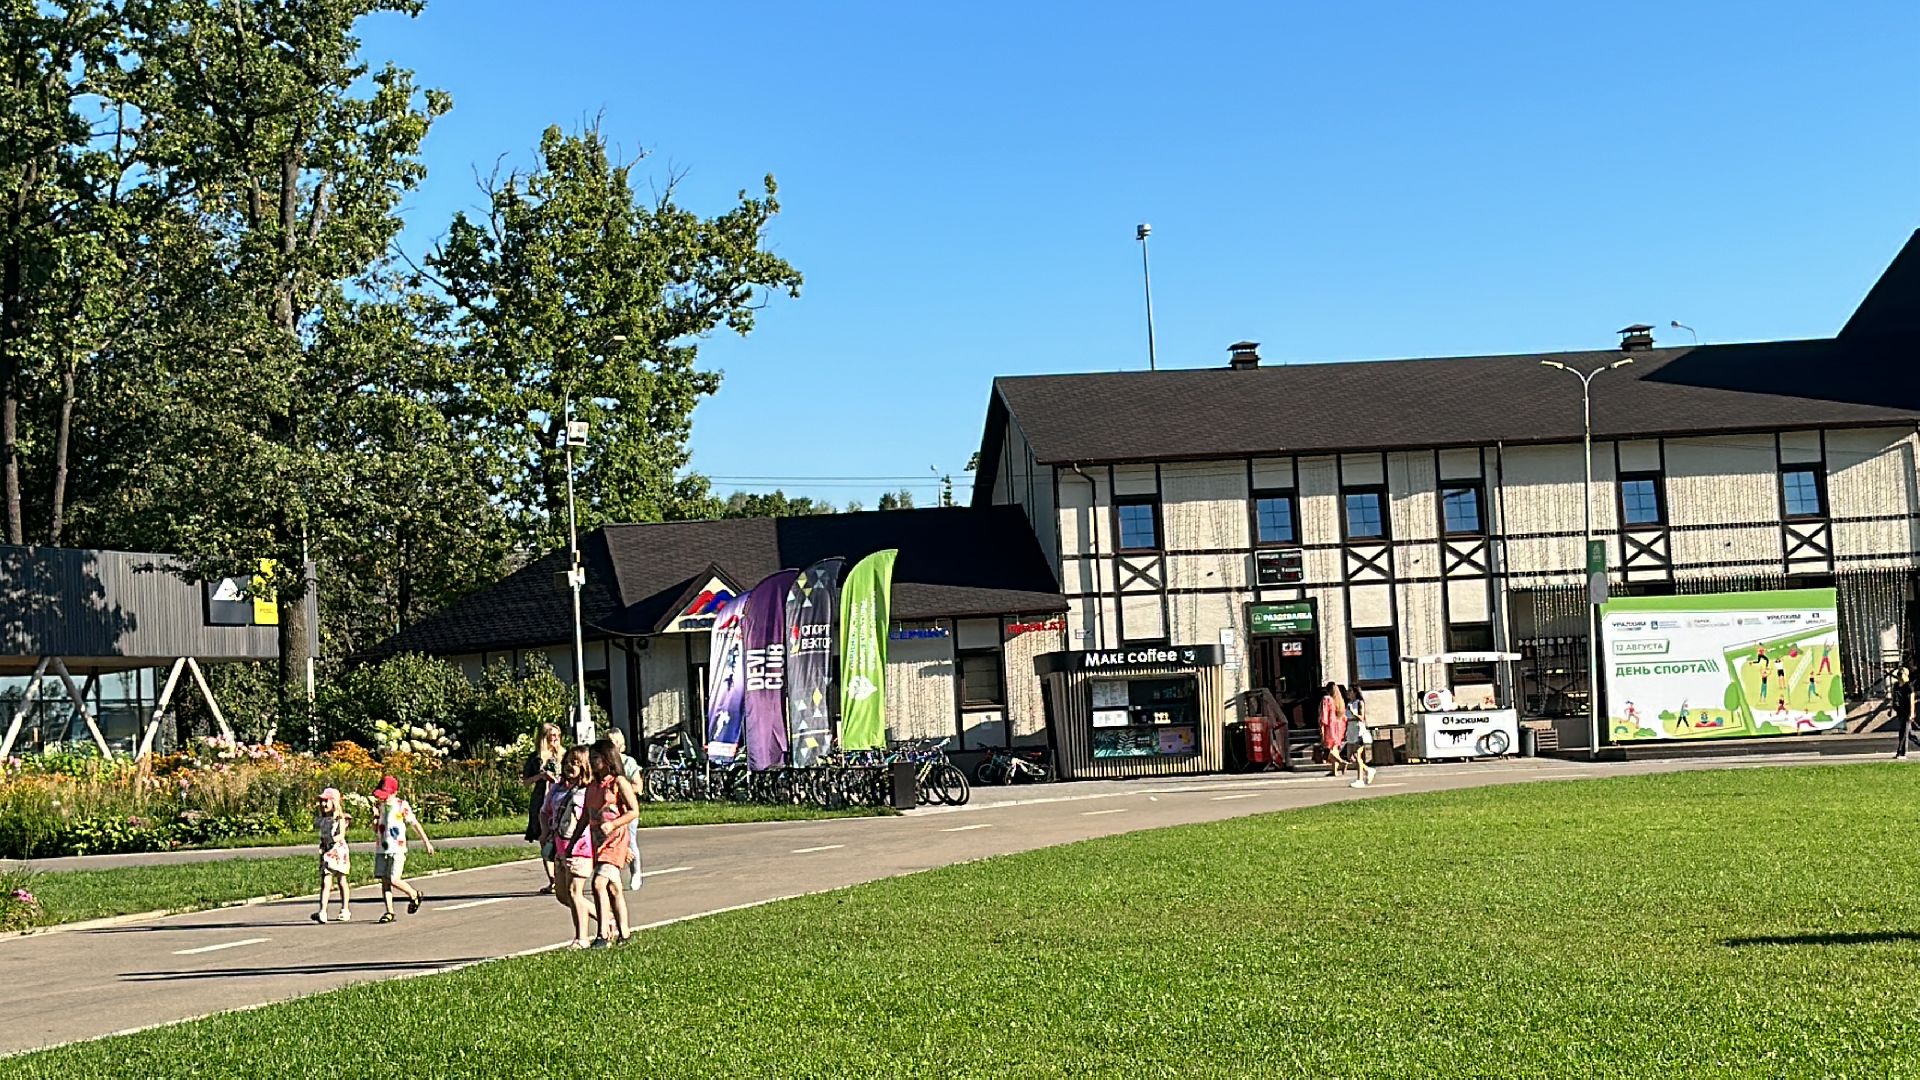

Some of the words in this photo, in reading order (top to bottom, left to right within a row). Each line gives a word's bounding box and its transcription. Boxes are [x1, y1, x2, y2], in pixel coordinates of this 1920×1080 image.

[1626, 642, 1664, 651] АВГУСТА
[1127, 648, 1178, 663] coffee
[746, 649, 766, 691] DEVI
[765, 643, 785, 690] CLUB
[1615, 666, 1651, 677] ДЕНЬ
[1653, 664, 1707, 675] СПОРТА
